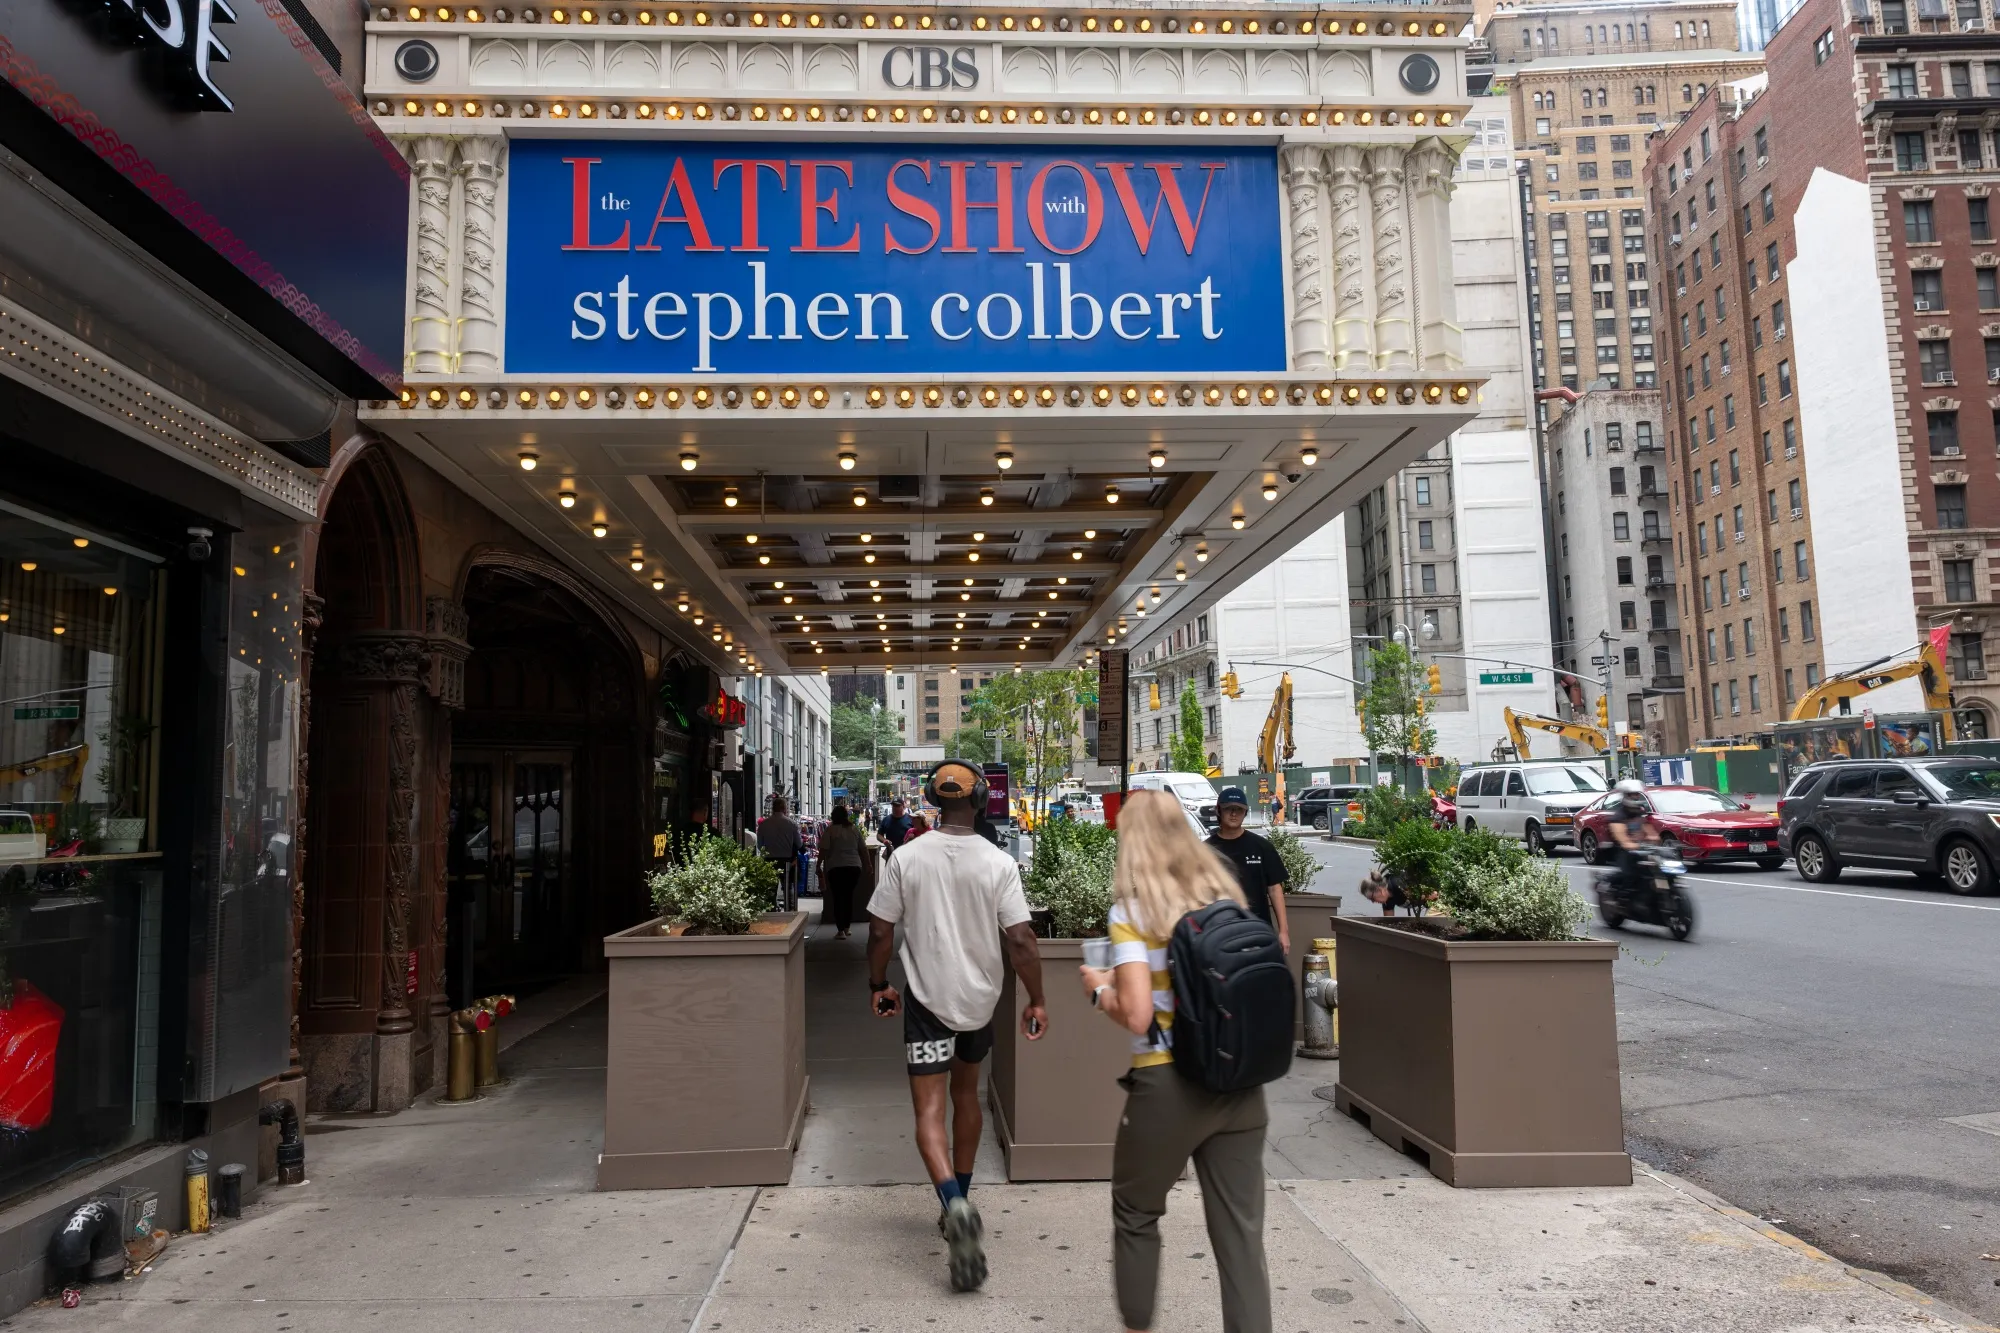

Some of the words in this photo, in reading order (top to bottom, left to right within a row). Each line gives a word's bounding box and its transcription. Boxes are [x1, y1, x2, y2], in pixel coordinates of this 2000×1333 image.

[881, 45, 980, 91] CBS
[561, 156, 860, 252] LATE
[884, 159, 1226, 255] SHOW
[600, 192, 631, 211] the
[1044, 195, 1087, 215] with
[571, 261, 909, 372] stephen
[930, 261, 1224, 341] colbert
[1491, 675, 1499, 683] W
[1513, 674, 1522, 682] St
[1867, 676, 1883, 689] CAT
[1549, 725, 1560, 733] CAT
